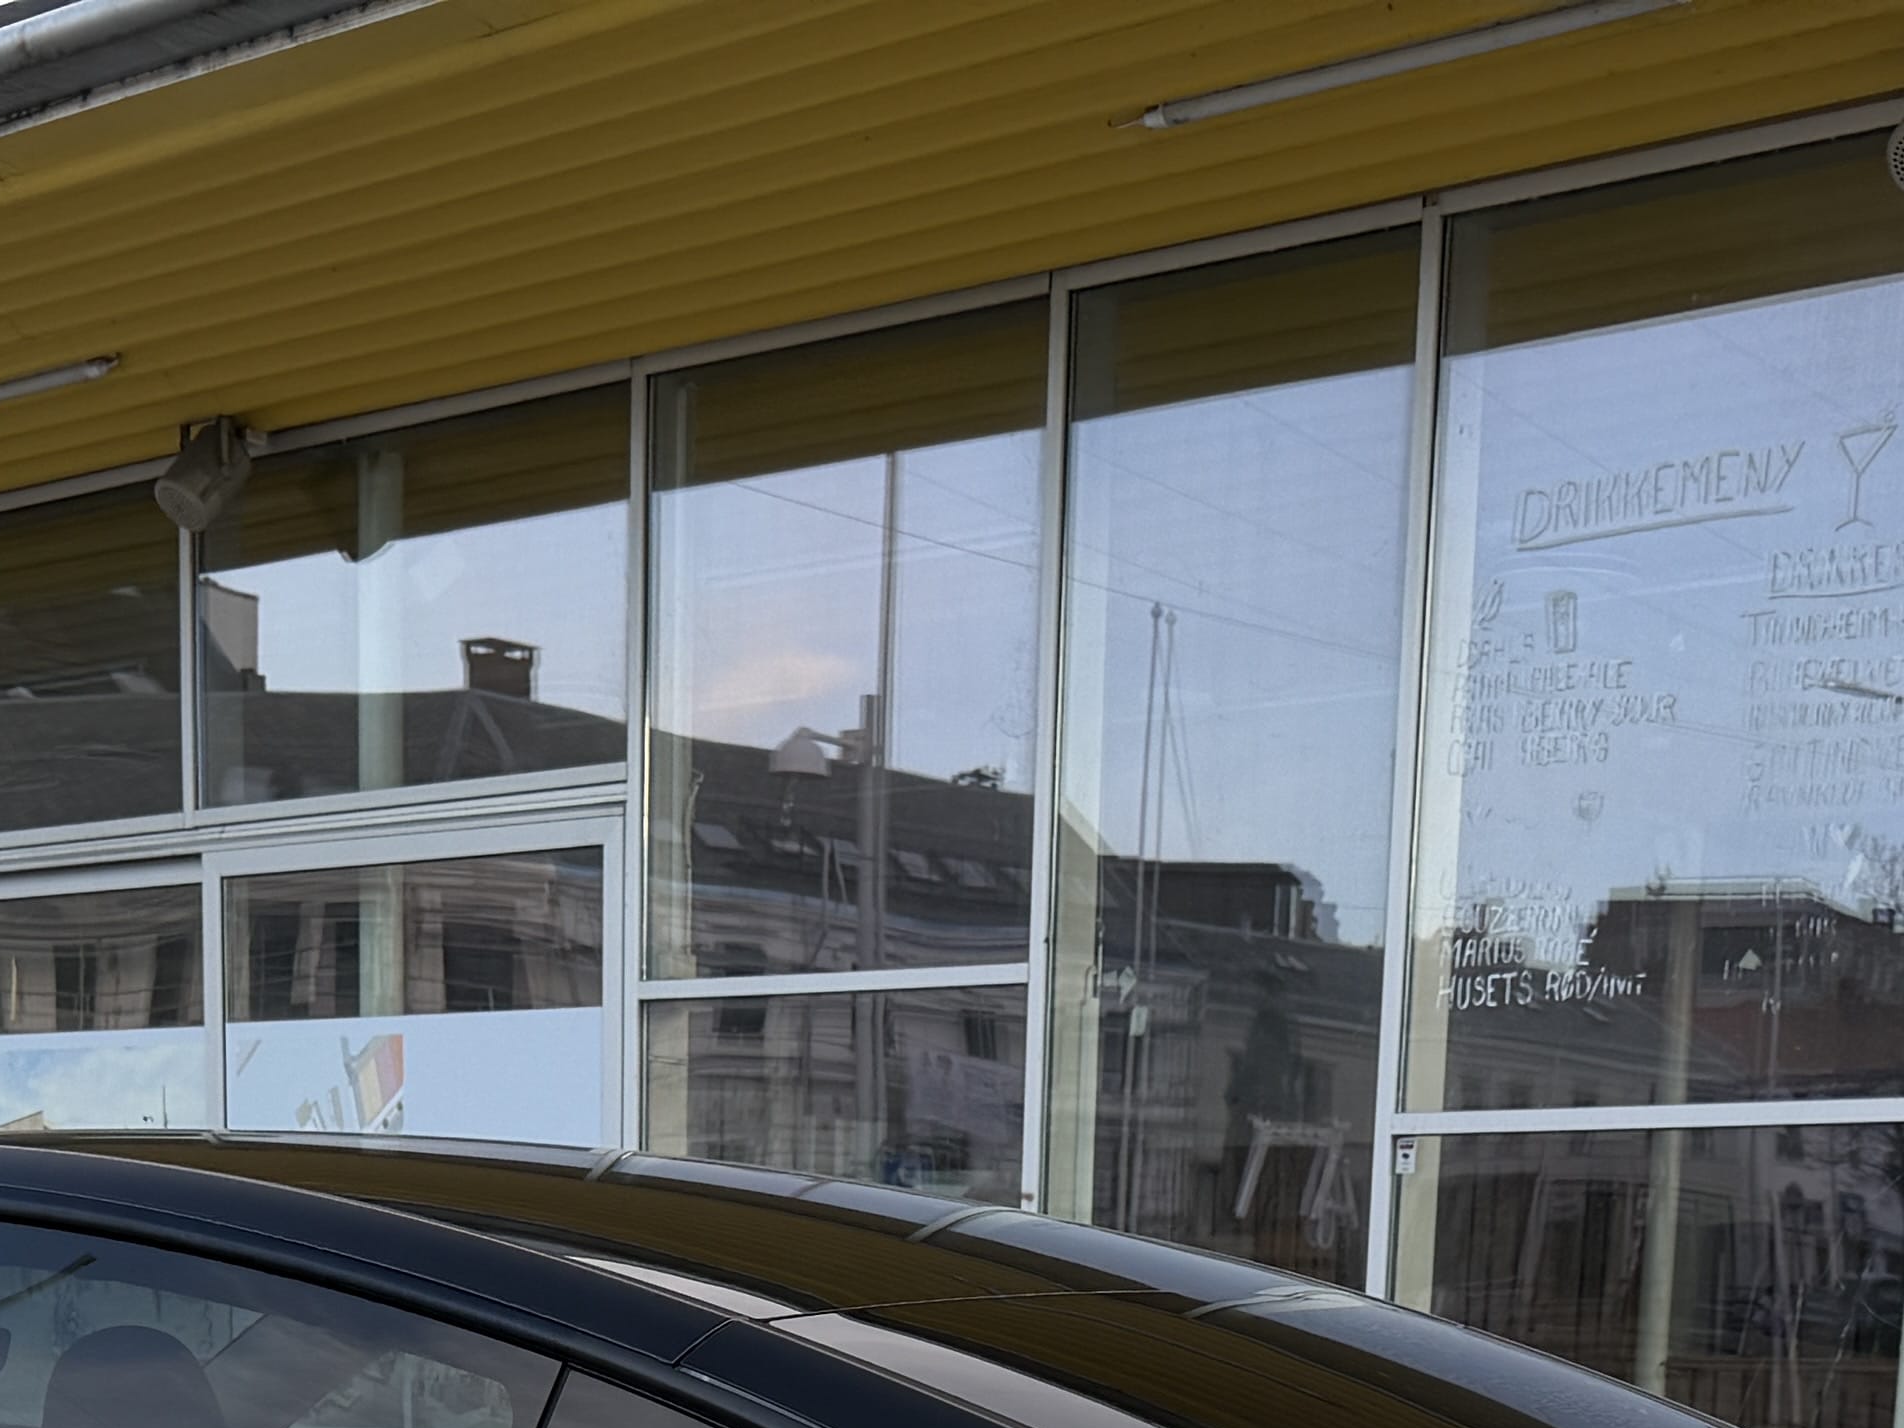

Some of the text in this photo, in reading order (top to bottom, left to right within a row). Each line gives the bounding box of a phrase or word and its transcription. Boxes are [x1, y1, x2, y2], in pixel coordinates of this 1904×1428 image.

[1511, 439, 1806, 545] DRIKKEMENY
[1439, 935, 1526, 970] MARIUS
[1437, 970, 1535, 1010] HUSETS
